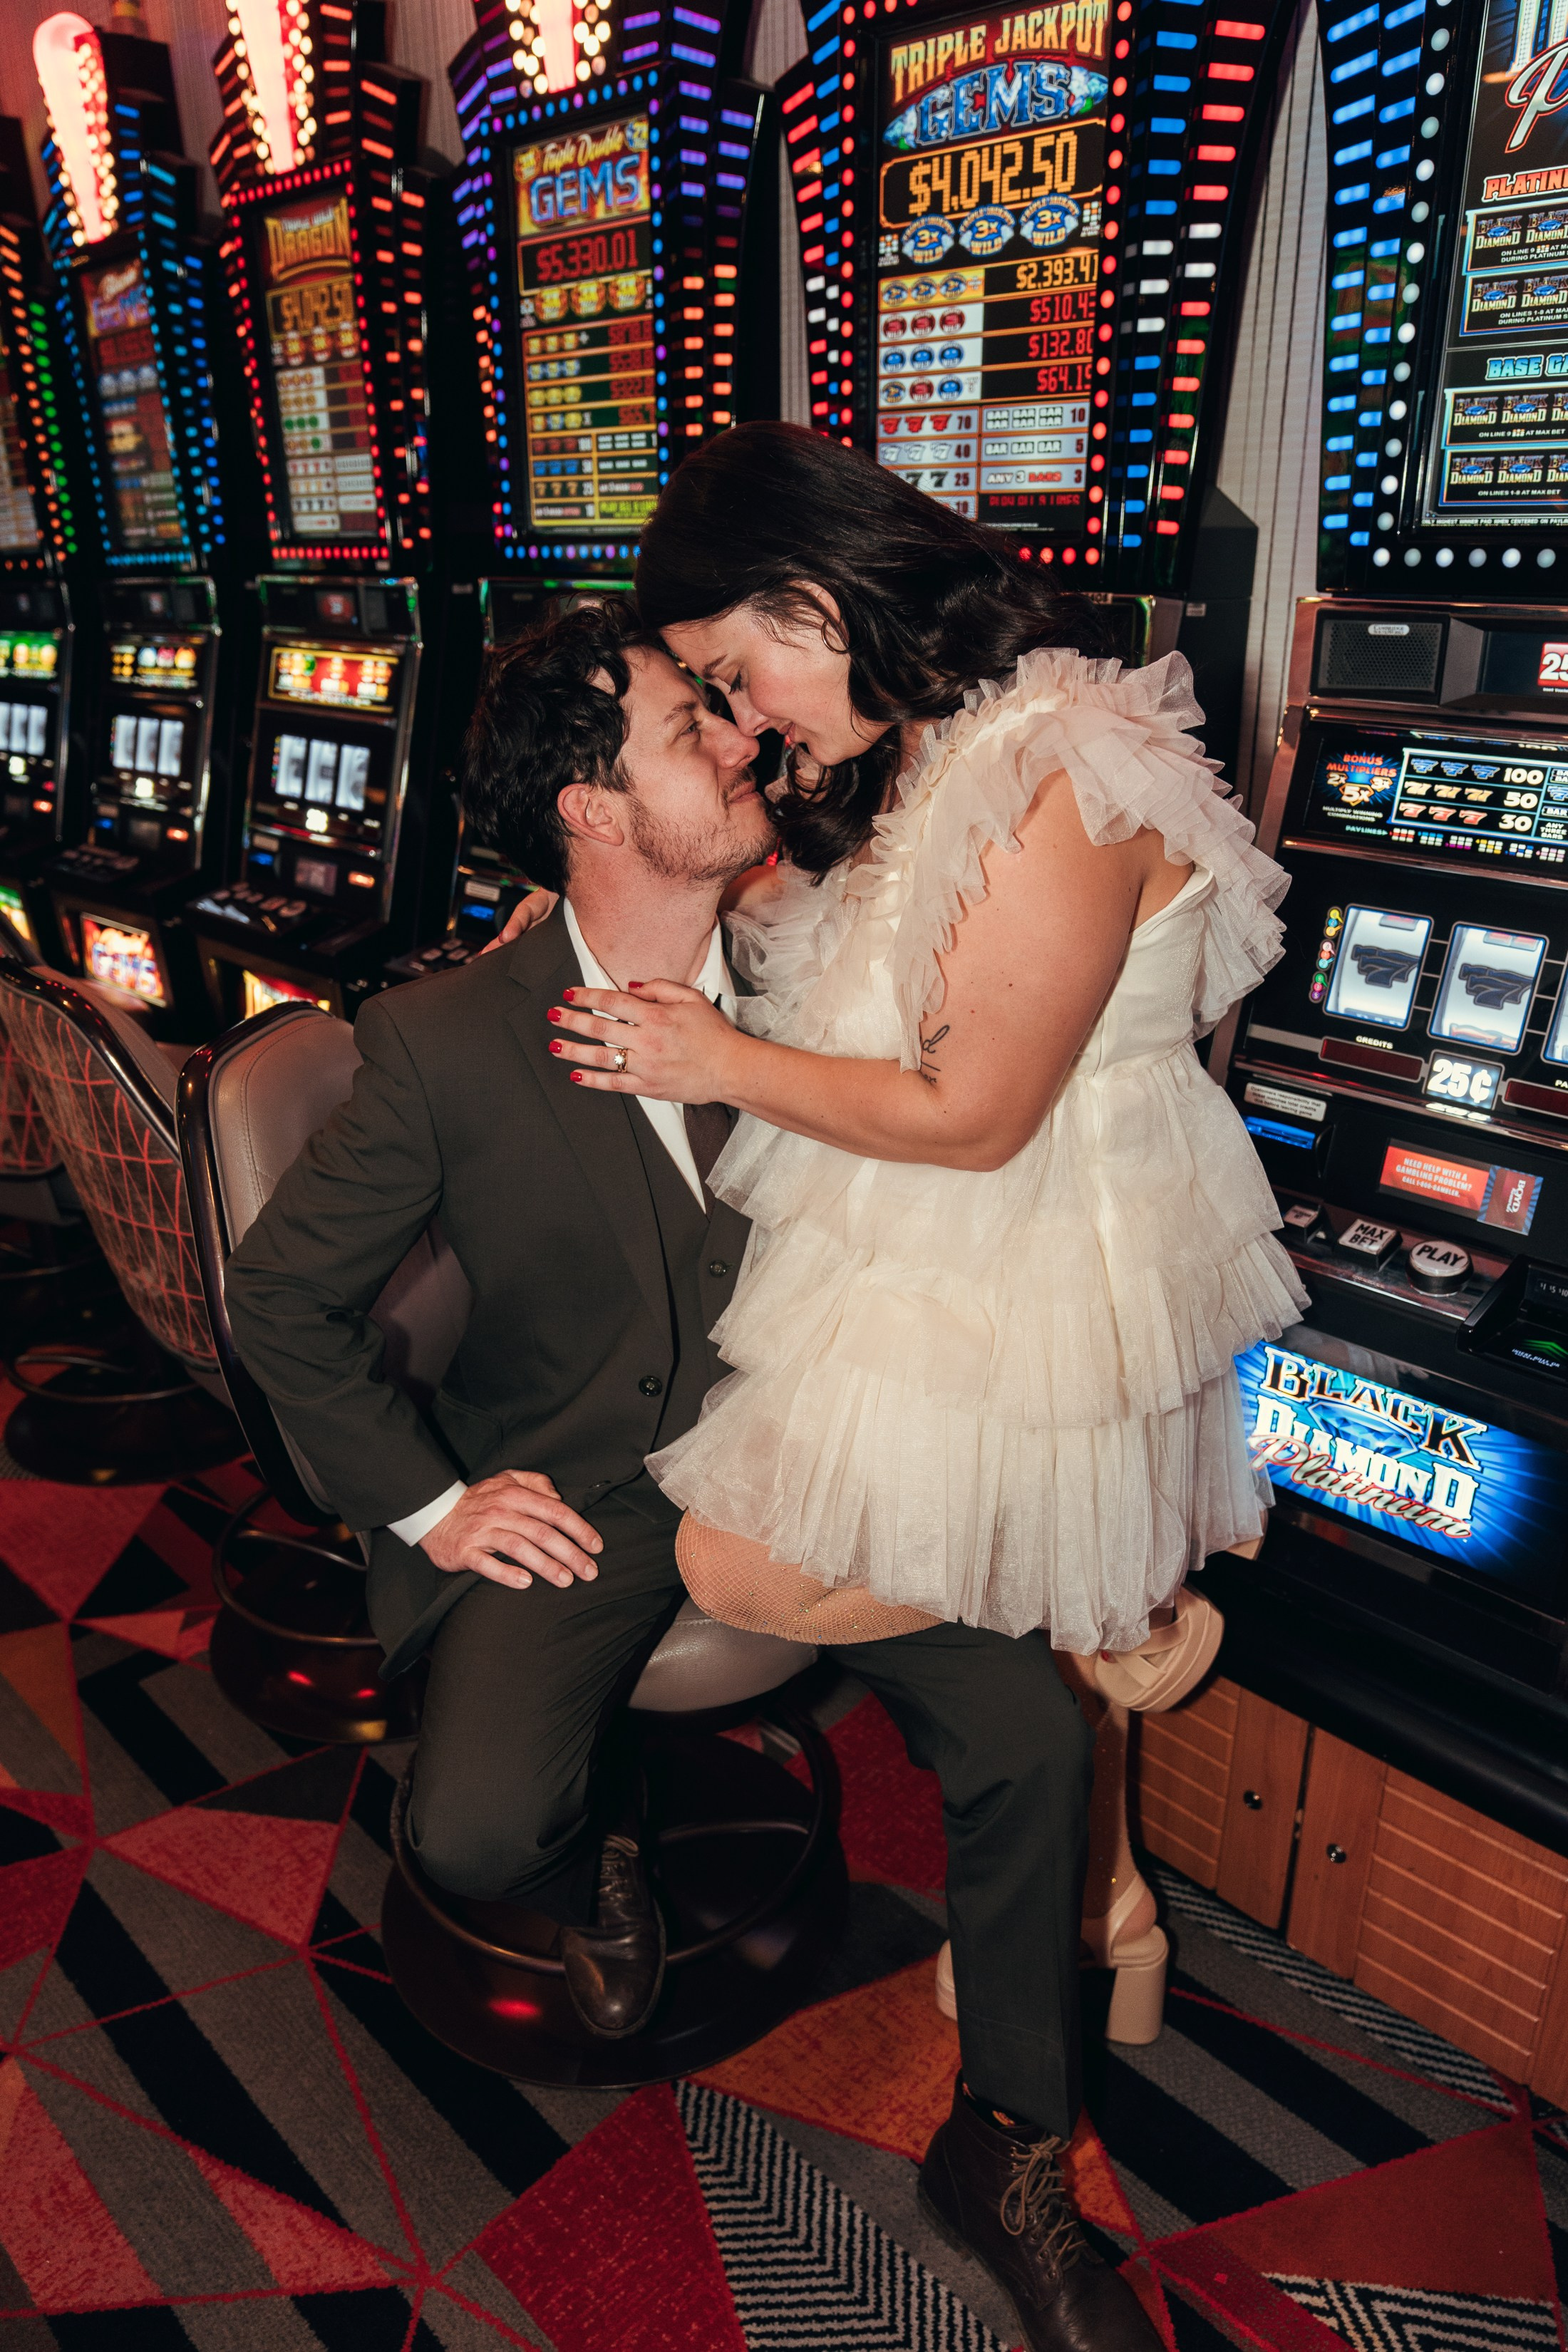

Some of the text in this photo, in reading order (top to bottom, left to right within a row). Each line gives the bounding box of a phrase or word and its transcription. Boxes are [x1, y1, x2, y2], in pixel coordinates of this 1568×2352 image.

[891, 0, 1109, 104] TRIPLE JACKPOT
[915, 61, 1071, 146] GEMS
[577, 124, 625, 167] Double
[909, 130, 1078, 216] $4,042.50
[530, 153, 641, 224] GEMS
[1477, 215, 1523, 235] BLACK
[1032, 227, 1067, 246] WILD
[1475, 231, 1522, 249] DIAMOND
[971, 237, 1003, 255] WILD
[913, 248, 943, 264] WILD
[1530, 251, 1566, 260] PLATINUM
[1473, 279, 1518, 298] BLACK
[1471, 295, 1517, 312] DIAMOND
[1527, 314, 1562, 323] PLATINUM
[1487, 356, 1544, 379] BASE
[1455, 393, 1549, 412] BLACK BLACK
[1071, 407, 1085, 423] 10
[1453, 408, 1547, 426] DIAMOND DIAMOND
[954, 443, 971, 458] 40
[1076, 438, 1083, 453] 5
[1452, 455, 1544, 471] BLACK BLACK
[954, 472, 970, 487] 25
[986, 473, 1013, 484] ANY
[1016, 470, 1026, 483] 3
[1074, 469, 1082, 483] 3
[1450, 469, 1542, 485] DIAMOND DIAMOND
[1343, 753, 1383, 765] BONUS
[1326, 762, 1397, 778] MULTIPLIERS
[1503, 767, 1544, 785] 100
[1503, 791, 1538, 809] 50
[1322, 805, 1383, 819] MULTIPLY WINNING
[1327, 812, 1376, 822] COMBINATIONS
[1346, 825, 1383, 835] PAYLINES
[1498, 813, 1532, 832] 30
[1540, 827, 1567, 835] THREE
[1356, 1035, 1394, 1050] CREDITS
[1427, 1058, 1493, 1103] 25¢
[1396, 1164, 1473, 1192] GAMBLING PROBLEM?
[1403, 1157, 1468, 1182] NEED HELP WITH A
[1402, 1176, 1415, 1186] CALL
[1512, 1179, 1527, 1213] BOYD
[1348, 1233, 1380, 1247] BET
[1354, 1222, 1389, 1241] MAX
[1416, 1244, 1465, 1267] PLAY
[1260, 1346, 1487, 1471] BLACK
[1254, 1393, 1480, 1522] DIAMOND
[1247, 1433, 1472, 1539] Platinum
